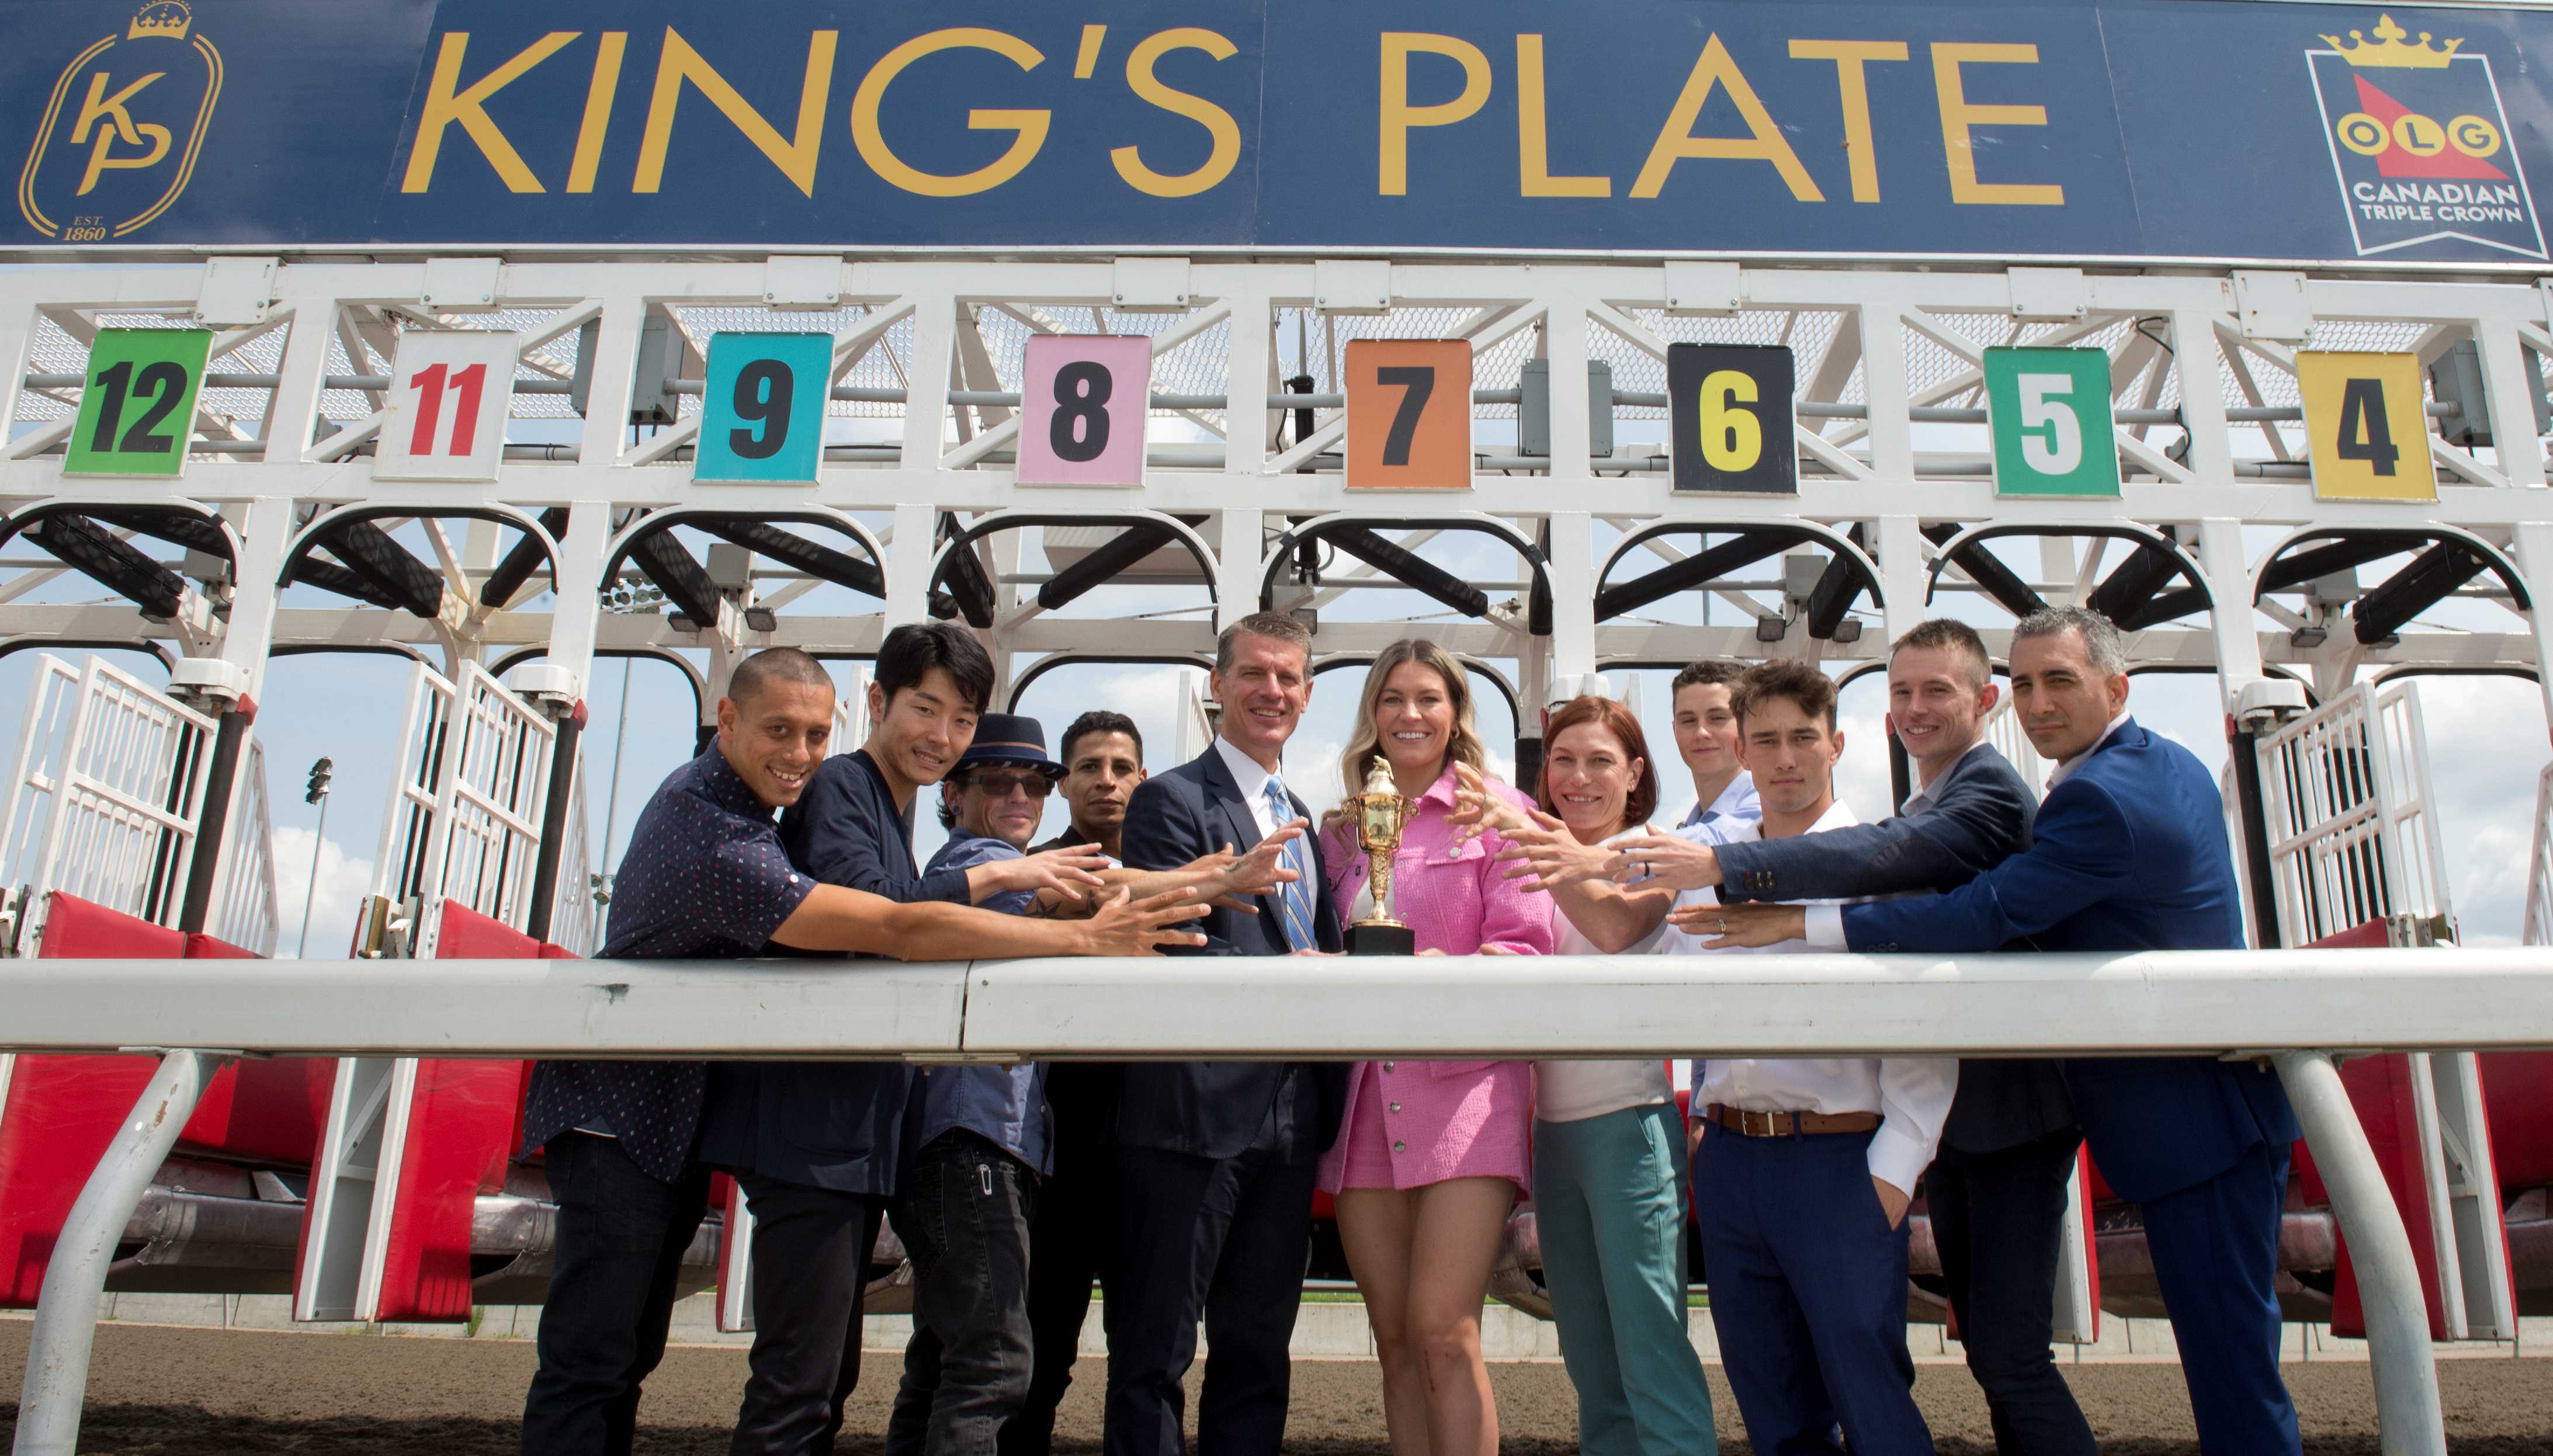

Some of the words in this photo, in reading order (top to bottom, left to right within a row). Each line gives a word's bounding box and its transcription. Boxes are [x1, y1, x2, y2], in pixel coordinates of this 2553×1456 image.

[401, 24, 1241, 197] KING'S
[1379, 32, 2065, 206] PLATE
[2347, 120, 2491, 151] OLG
[63, 227, 106, 241] 1860
[74, 216, 103, 225] EST.
[2353, 182, 2520, 204] CANADIAN
[2359, 204, 2434, 221] TRIPLE
[2437, 206, 2523, 223] CROWN
[91, 361, 188, 453] 12
[410, 363, 487, 456] 11
[729, 359, 794, 459] 9
[1049, 360, 1113, 463] 8
[1378, 367, 1435, 465] 7
[1699, 370, 1763, 472] 6
[2017, 373, 2082, 475] 5
[2337, 378, 2399, 476] 4
